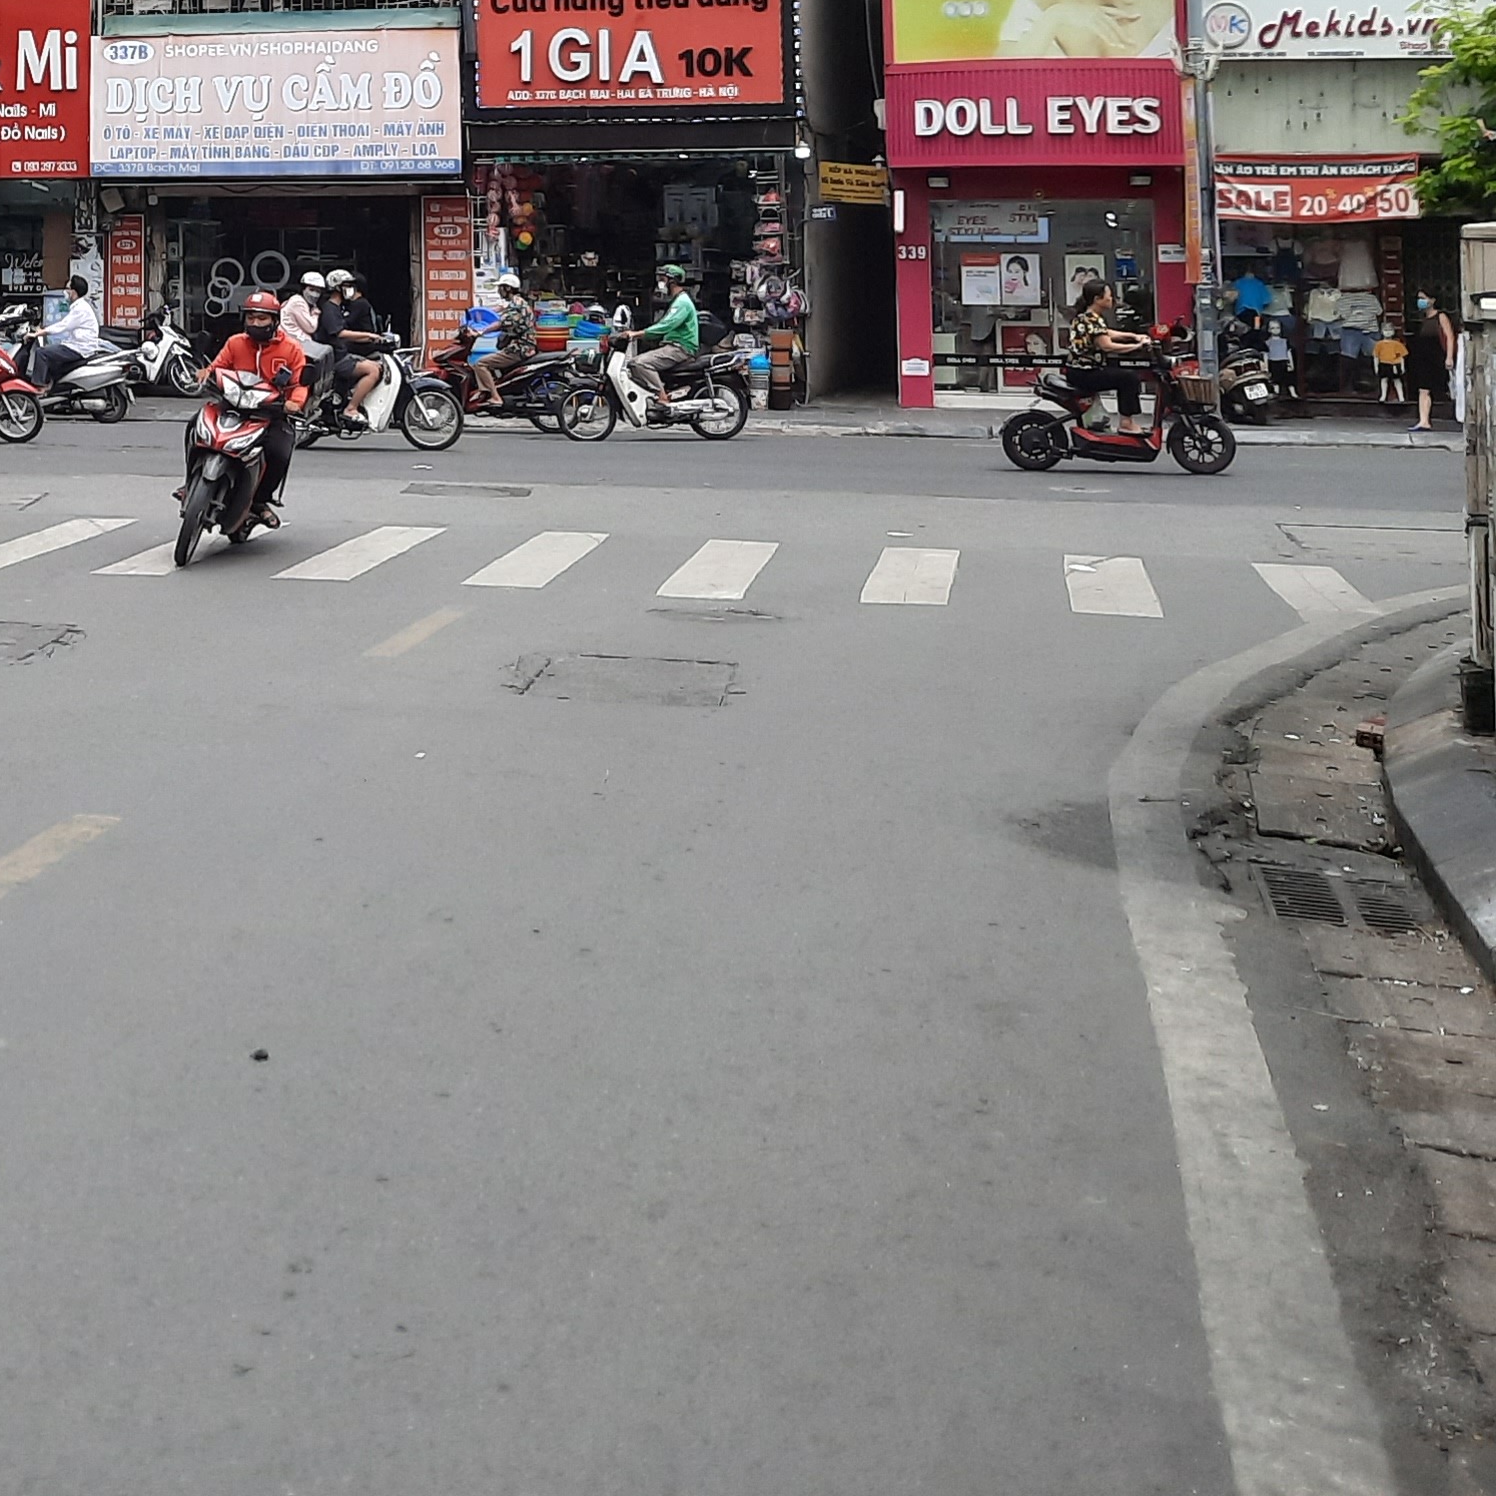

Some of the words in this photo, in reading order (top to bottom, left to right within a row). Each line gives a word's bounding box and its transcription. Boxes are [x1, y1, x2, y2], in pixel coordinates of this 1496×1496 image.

[15, 29, 78, 92] Mi
[109, 45, 149, 60] 337B
[509, 29, 534, 83] 1
[678, 47, 754, 78] 10K
[105, 75, 203, 123] DỊCH
[212, 74, 273, 122] VỤ
[282, 54, 372, 112] CẦM
[382, 51, 443, 110] ĐỒ
[914, 98, 1033, 137] DOLL
[1046, 96, 1161, 135] EYES
[115, 124, 131, 140] TÔ
[144, 127, 159, 140] XE
[164, 123, 191, 140] MÁY
[204, 126, 219, 140] XE
[331, 124, 370, 141] THOẠI
[383, 120, 412, 137] MÁY
[416, 117, 444, 136] ẢNH
[110, 147, 157, 160] LAPTOP
[170, 143, 197, 160] MÁY
[201, 143, 231, 160] TÍNH
[235, 141, 270, 159] BẢNG
[353, 143, 399, 157] AMPLY
[412, 143, 438, 156] LOA
[417, 161, 431, 169] 68
[434, 160, 455, 169] 968
[1279, 165, 1297, 176] EM
[1299, 165, 1319, 176] TRI
[1340, 162, 1381, 175] KHÁCH
[1217, 187, 1291, 213] SALE
[897, 245, 927, 260] 339
